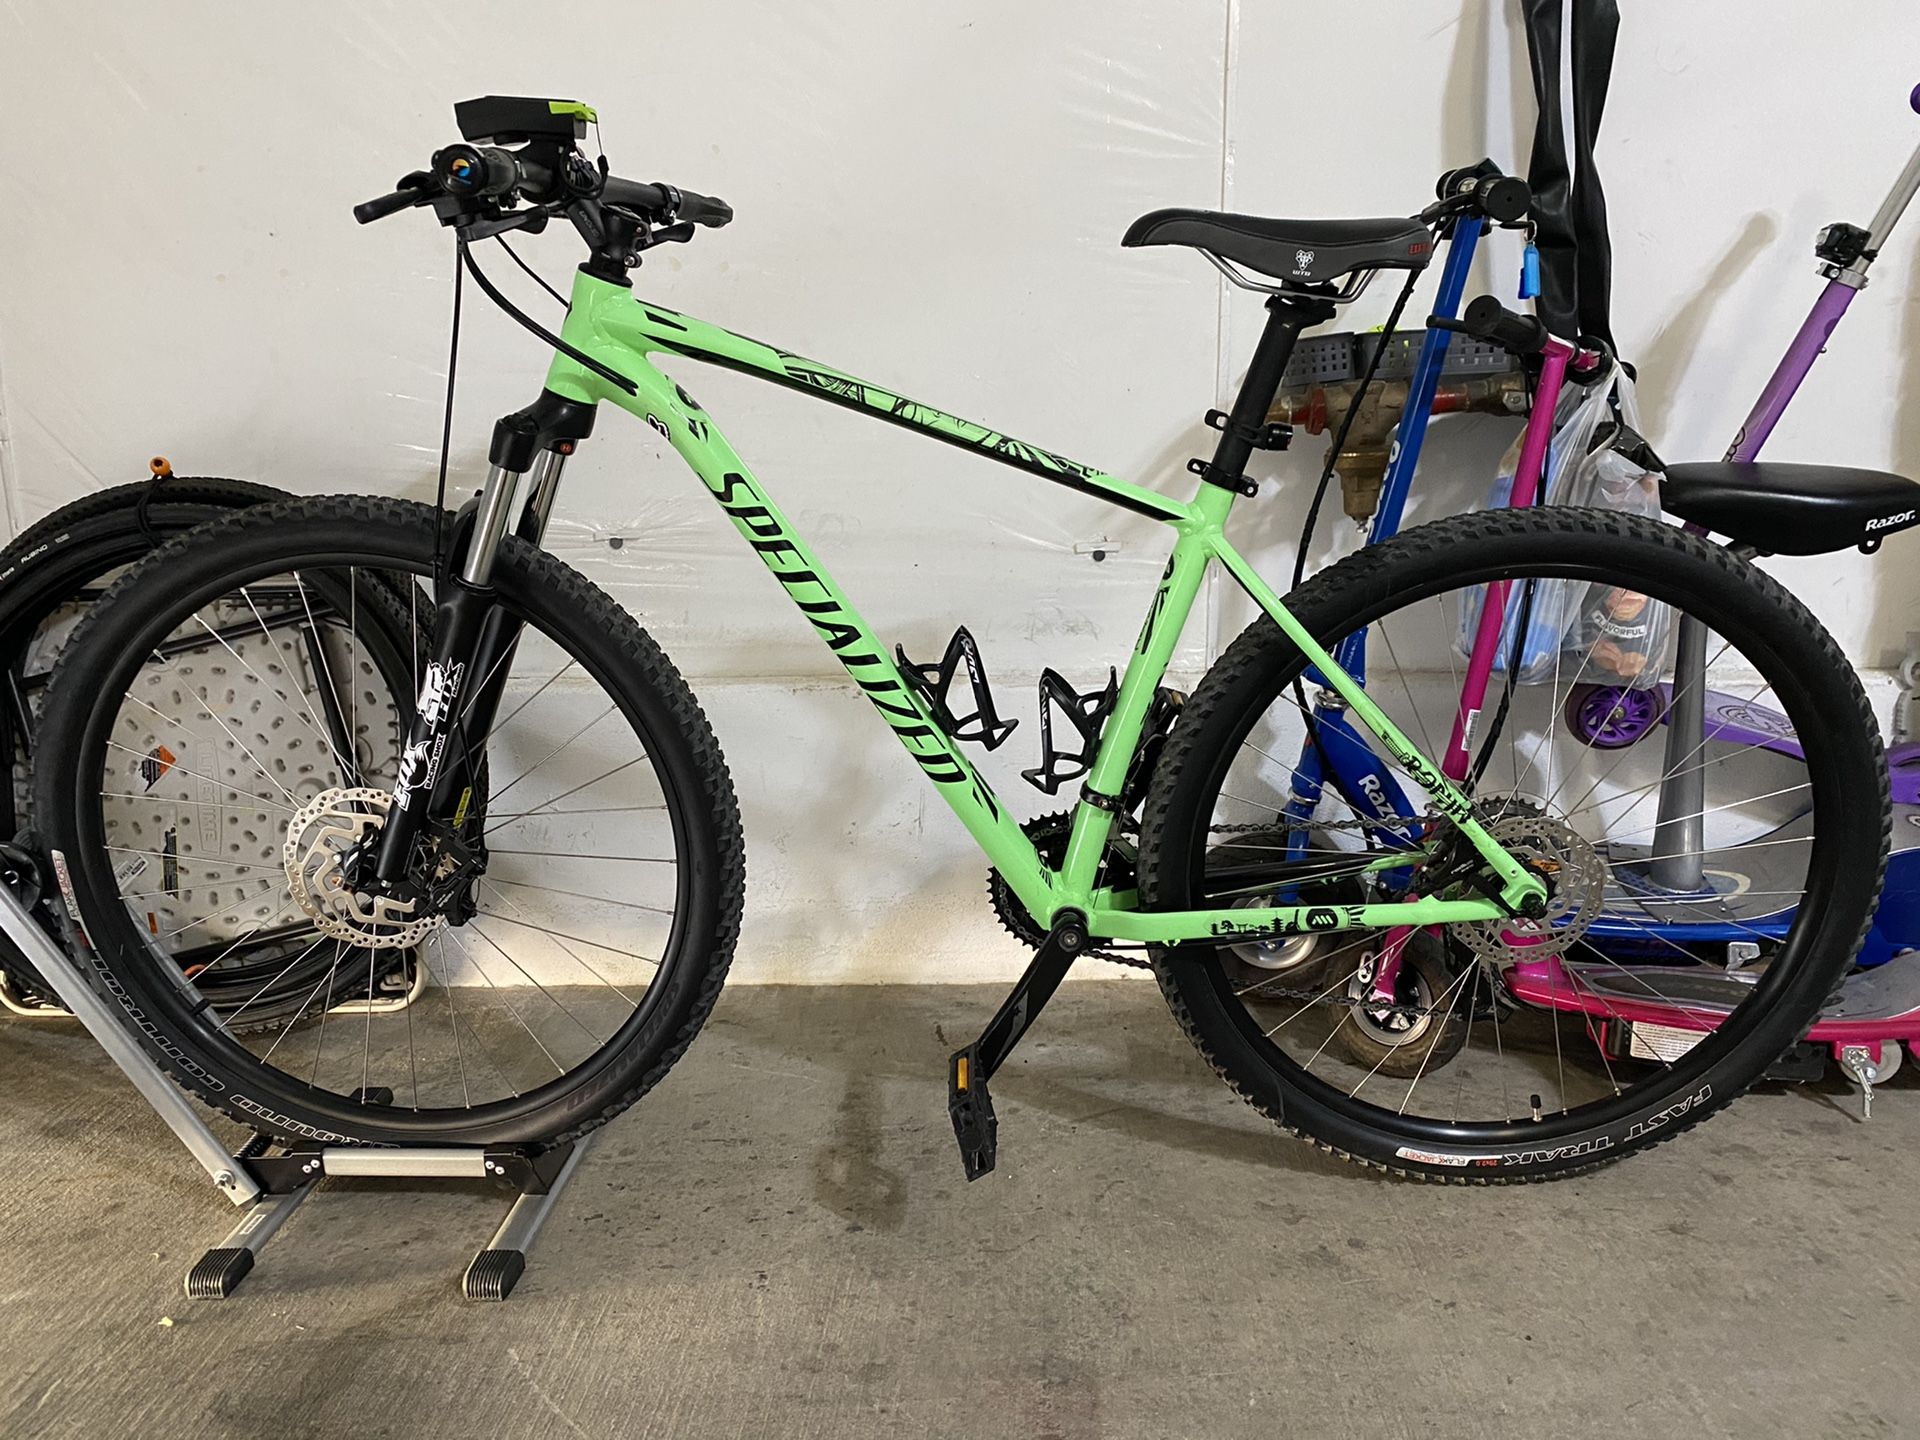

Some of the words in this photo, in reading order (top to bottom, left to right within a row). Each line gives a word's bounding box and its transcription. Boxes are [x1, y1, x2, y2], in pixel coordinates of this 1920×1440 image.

[20, 543, 49, 564] RUBINO
[697, 471, 968, 784] SPECIALIZED
[435, 656, 461, 722] FOX
[392, 730, 423, 812] FOX
[424, 757, 439, 789] RACING
[433, 735, 445, 758] SHOX
[90, 954, 226, 1092] CONTROL
[1623, 1083, 1714, 1142] FAST
[1503, 1135, 1614, 1166] TRAK
